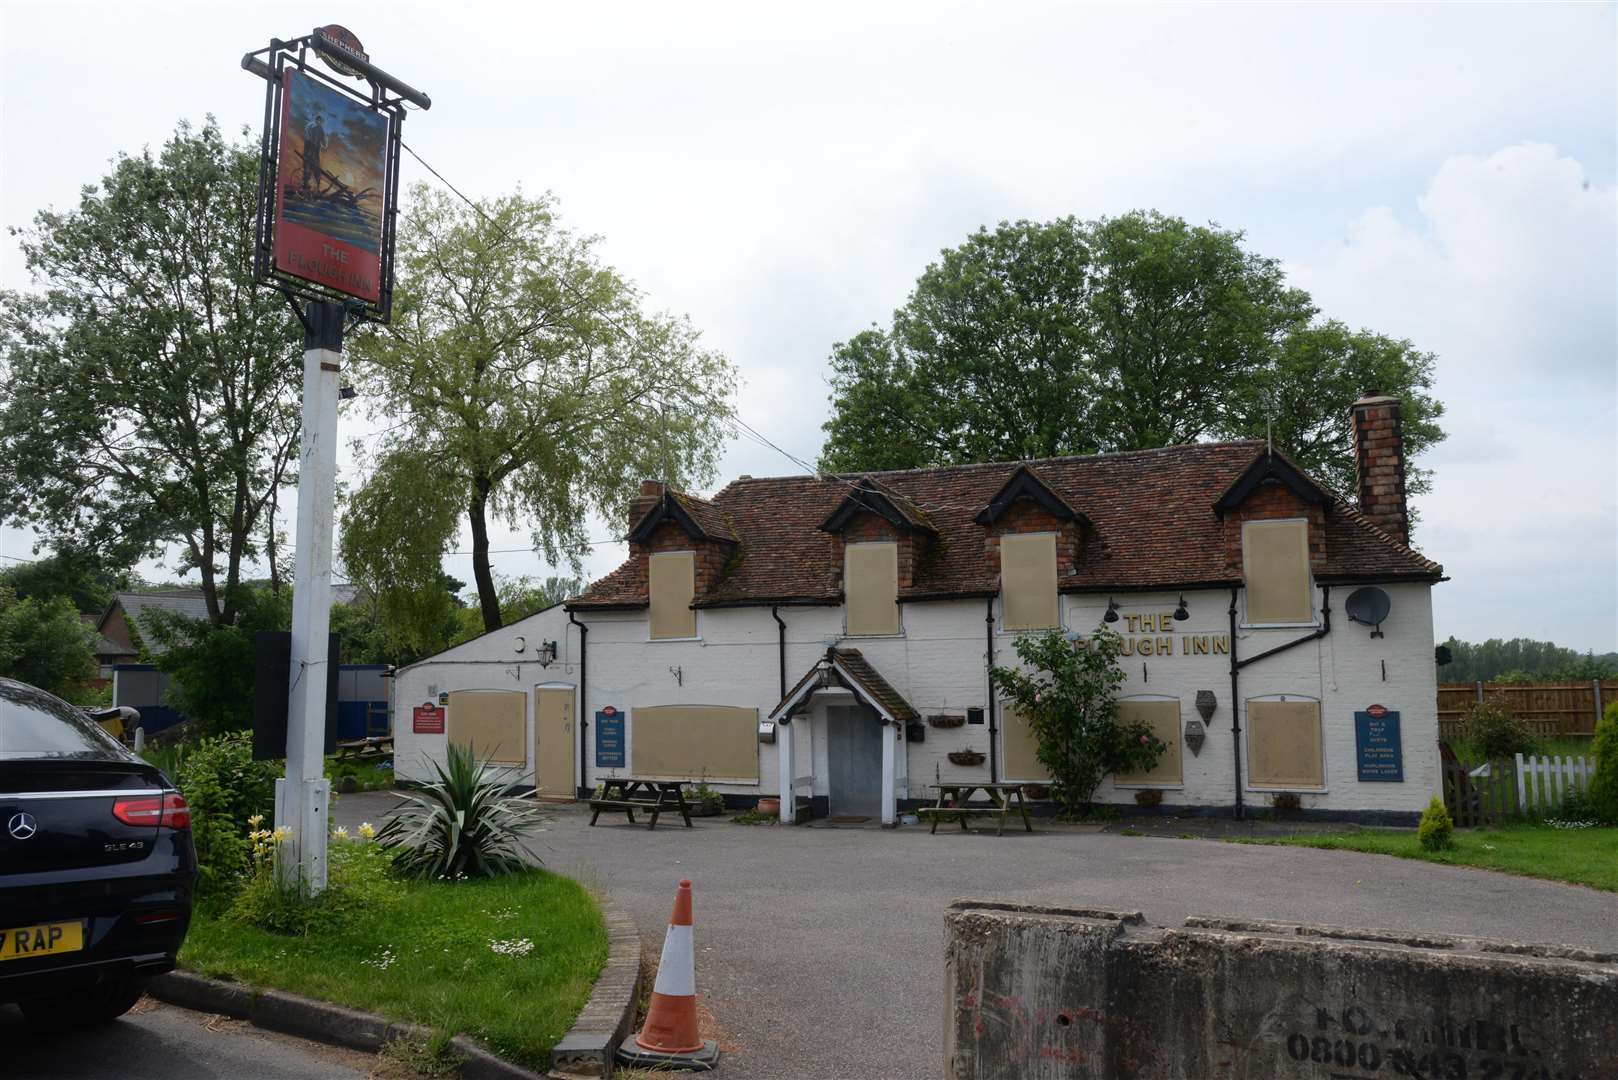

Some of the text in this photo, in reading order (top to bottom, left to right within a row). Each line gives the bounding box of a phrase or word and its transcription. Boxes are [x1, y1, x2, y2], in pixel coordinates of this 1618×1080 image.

[320, 32, 367, 61] SHEPHERD
[323, 242, 349, 265] THE
[288, 250, 348, 284] PLOUGH
[351, 270, 375, 292] INN
[1123, 613, 1175, 632] THE
[1183, 635, 1230, 655] INN
[15, 926, 63, 953] RAP
[1287, 1033, 1381, 1071] 0800
